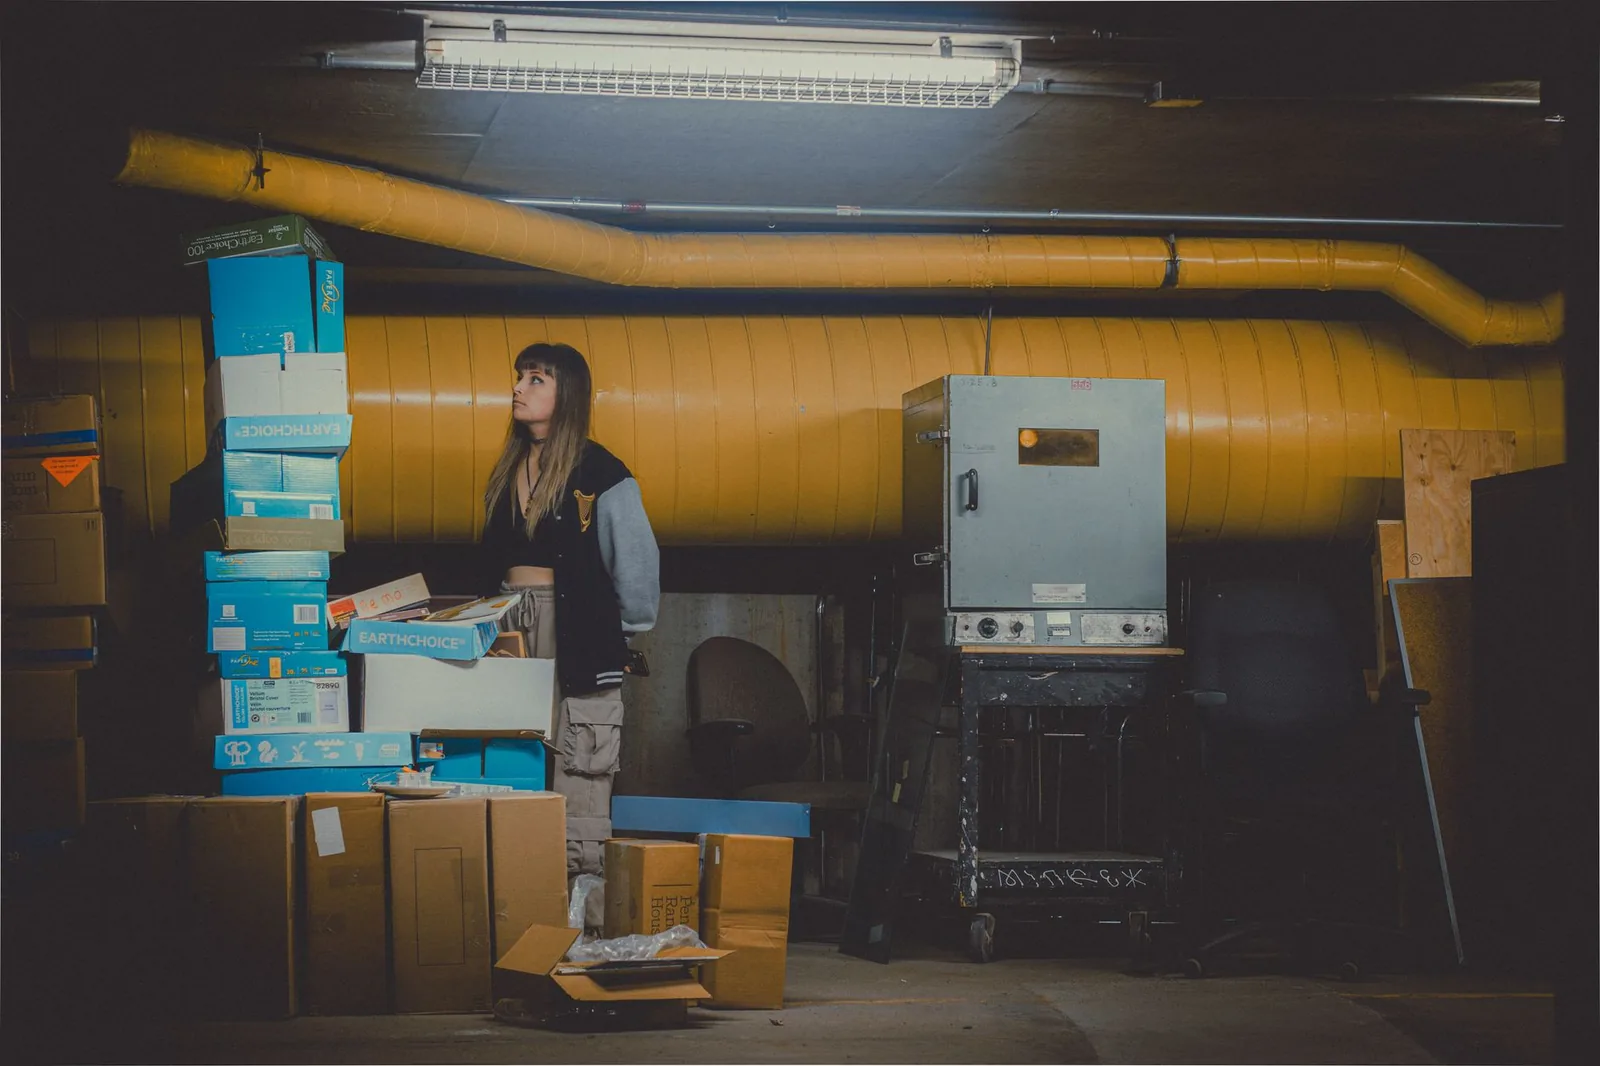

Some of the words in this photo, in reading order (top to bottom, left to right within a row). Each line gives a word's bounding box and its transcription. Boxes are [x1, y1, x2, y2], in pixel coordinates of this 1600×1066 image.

[240, 423, 341, 437] EARTHCHOICE
[358, 632, 461, 650] EARTHCHOICE
[651, 897, 664, 935] Hous
[680, 896, 692, 924] Pen
